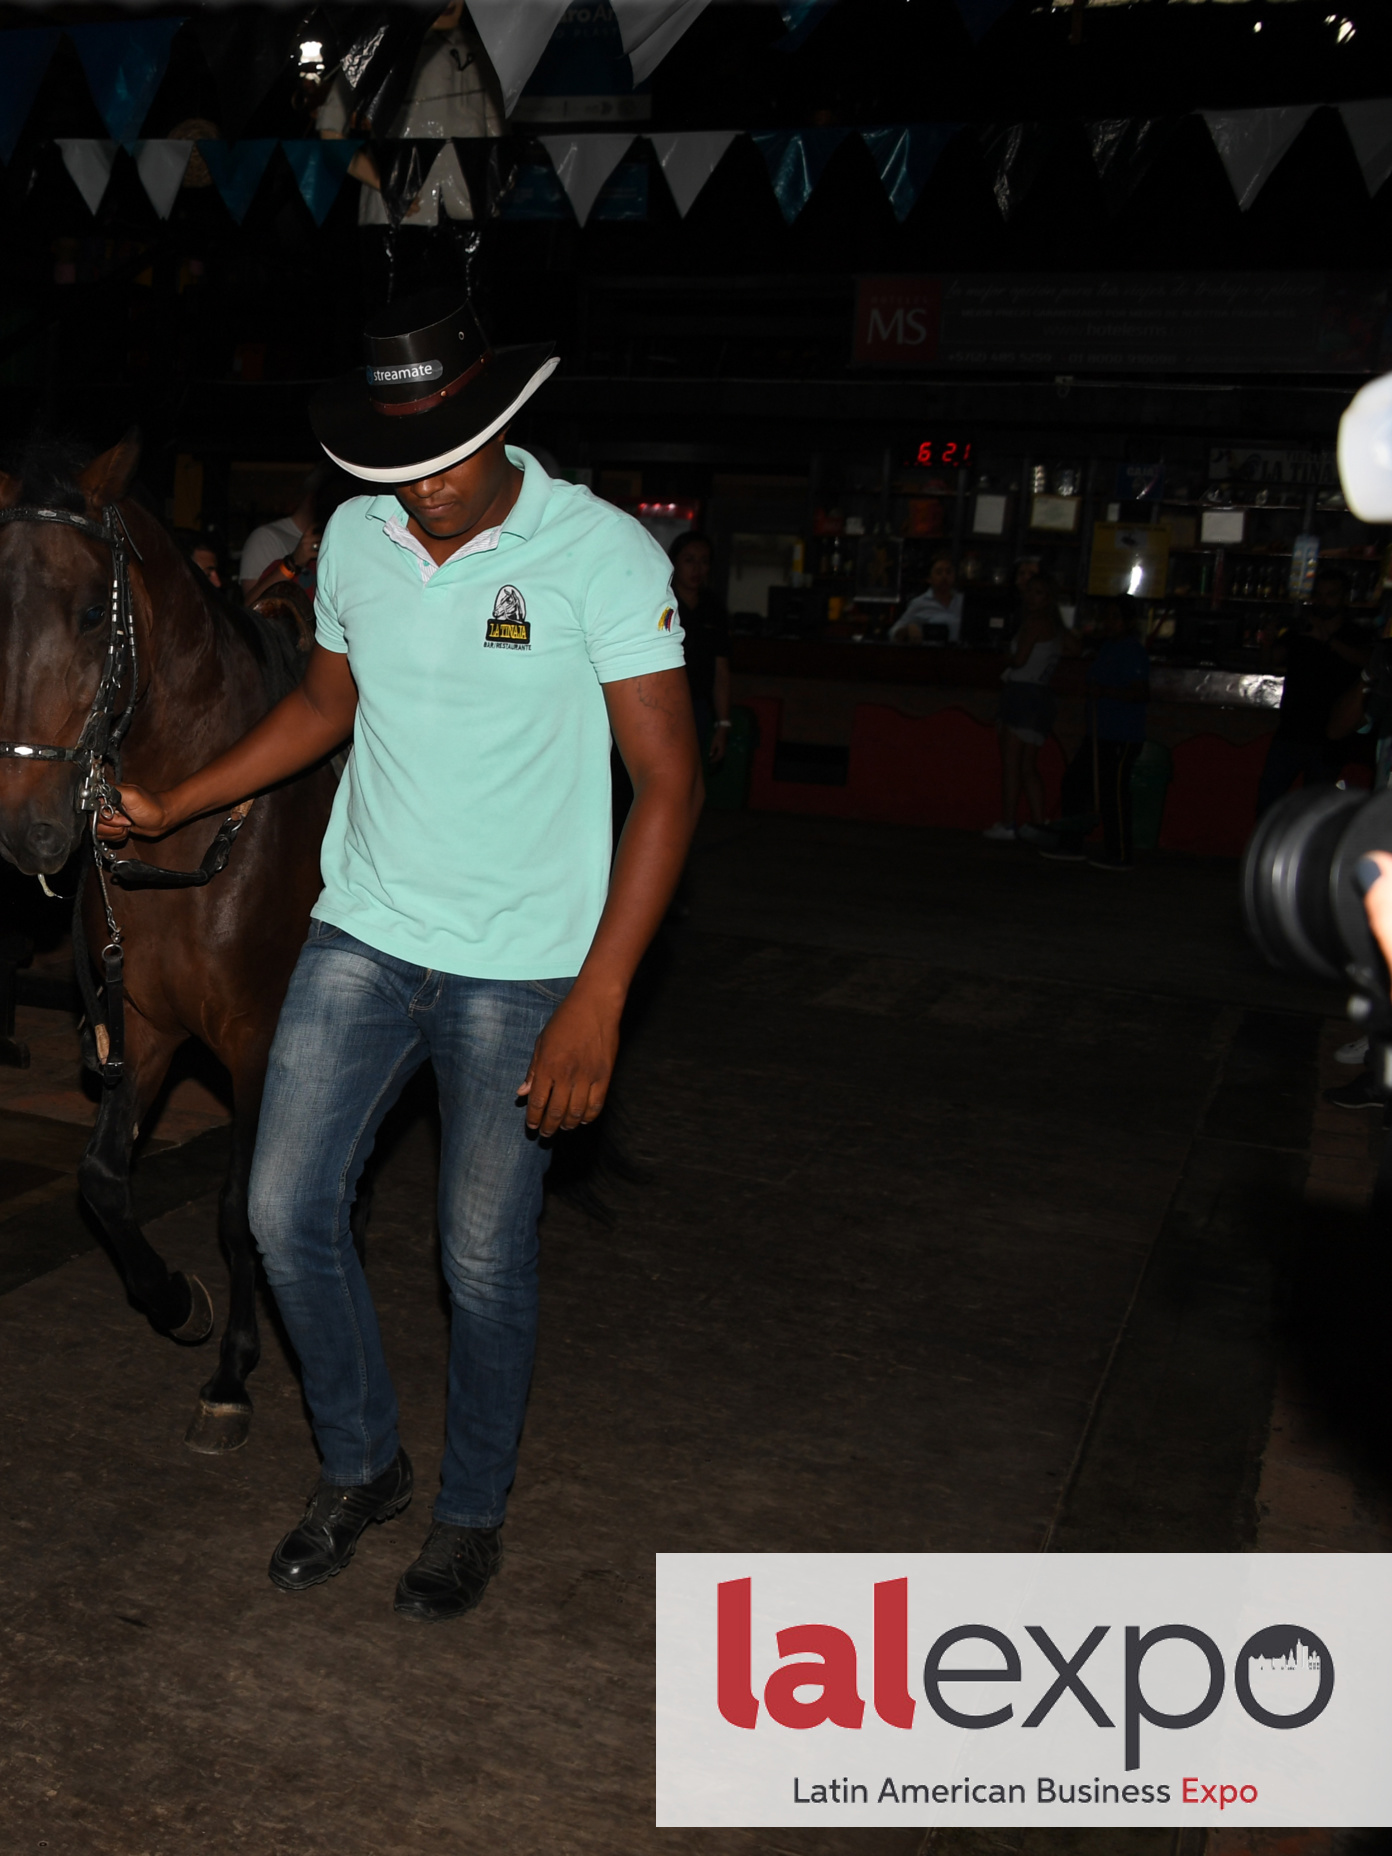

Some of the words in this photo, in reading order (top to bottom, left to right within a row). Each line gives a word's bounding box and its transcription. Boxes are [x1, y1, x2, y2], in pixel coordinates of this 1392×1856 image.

[866, 308, 928, 346] MS
[373, 364, 433, 382] streamate
[489, 623, 500, 638] LA
[500, 624, 527, 640] TINAJA
